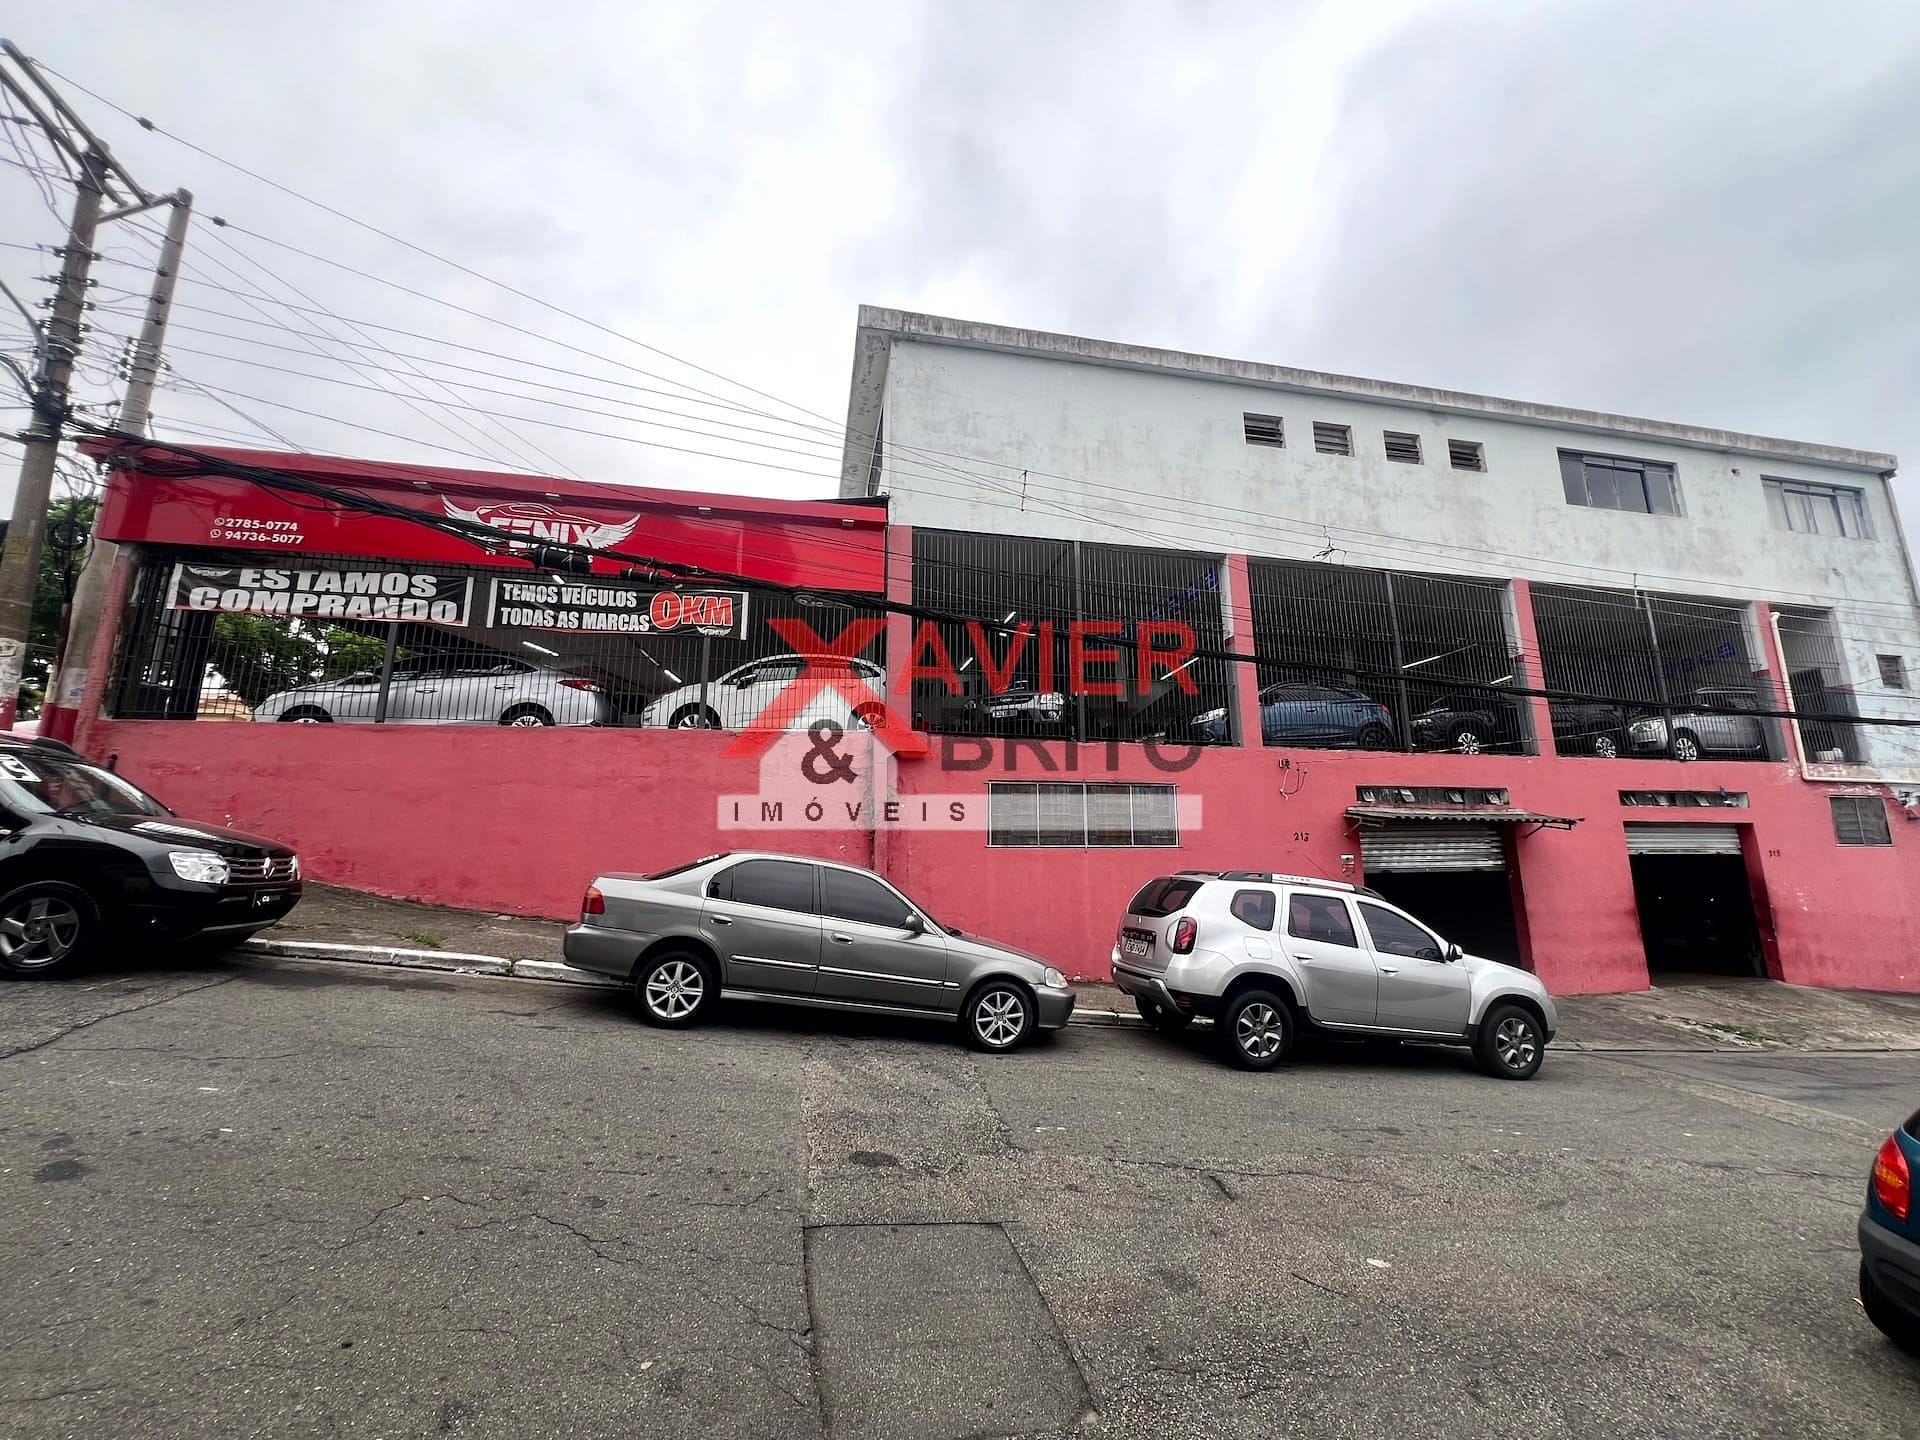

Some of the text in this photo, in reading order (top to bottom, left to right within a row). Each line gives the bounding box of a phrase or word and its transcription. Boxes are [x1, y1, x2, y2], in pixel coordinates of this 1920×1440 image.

[225, 518, 298, 532] 2785-0774
[225, 531, 304, 545] 94736-5077
[238, 568, 438, 598] ESTAMOS
[503, 583, 637, 608] TEMOS VEÍCULOS
[189, 587, 457, 622] COMPRANDO
[501, 608, 650, 633] TODAS AS MARCAS
